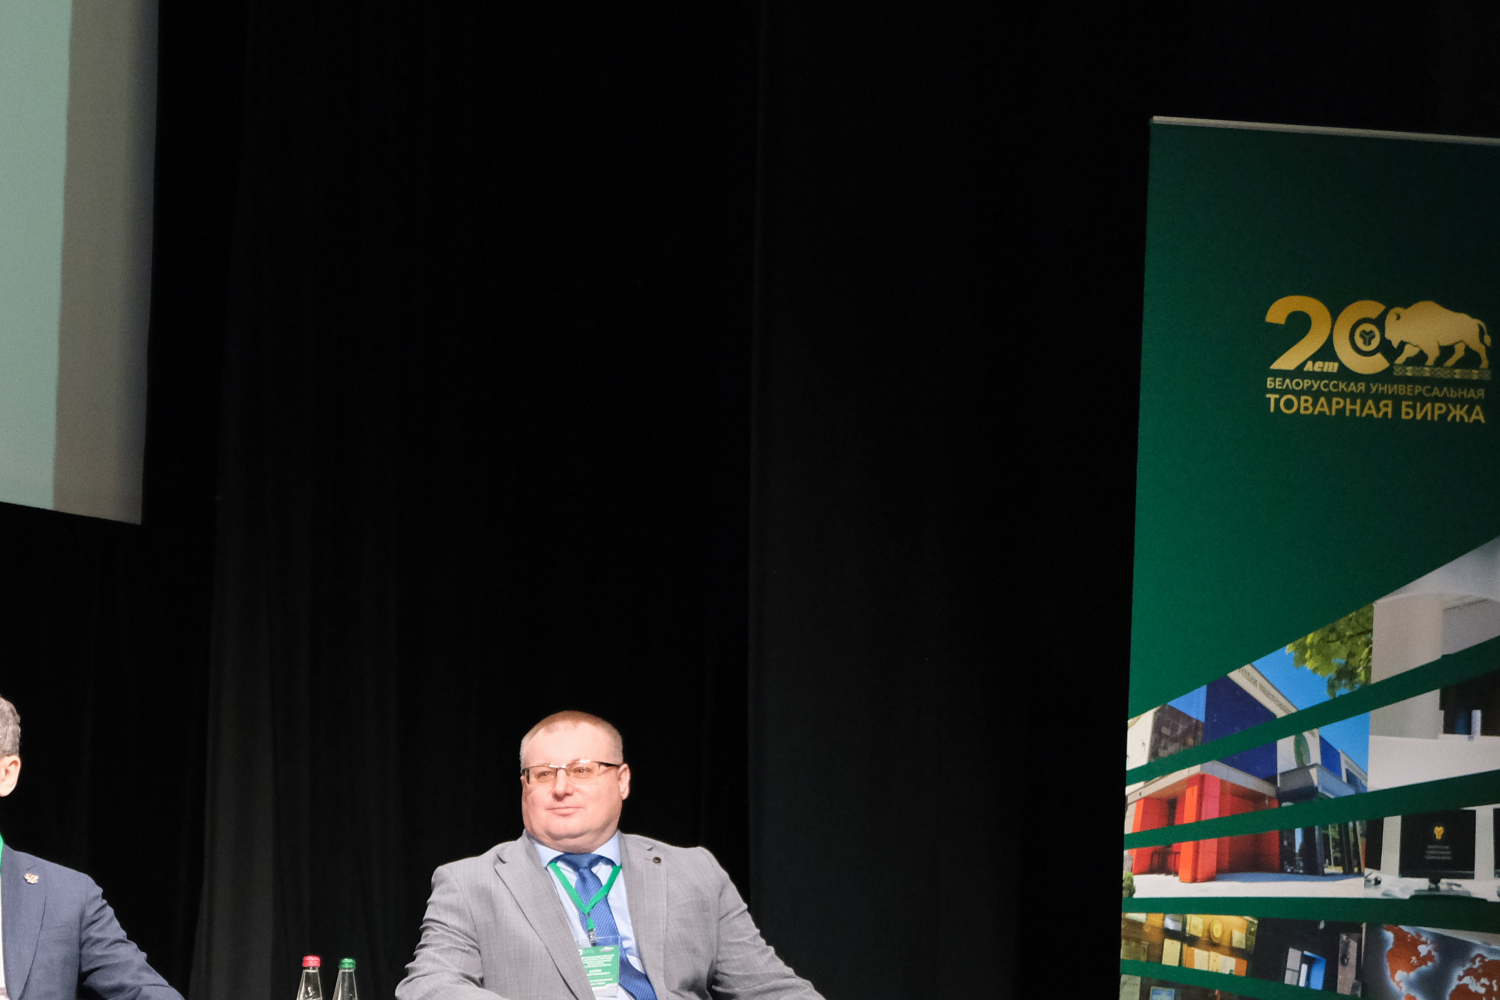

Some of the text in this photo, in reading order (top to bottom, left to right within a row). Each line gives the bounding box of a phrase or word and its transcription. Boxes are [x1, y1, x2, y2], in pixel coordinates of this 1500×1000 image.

[1303, 359, 1340, 373] лет
[1266, 376, 1486, 400] БЕЛОРУССКАЯ УНИВЕРСАЛЬНАЯ
[1265, 393, 1487, 424] ТОВАРНАЯ БИРЖА
